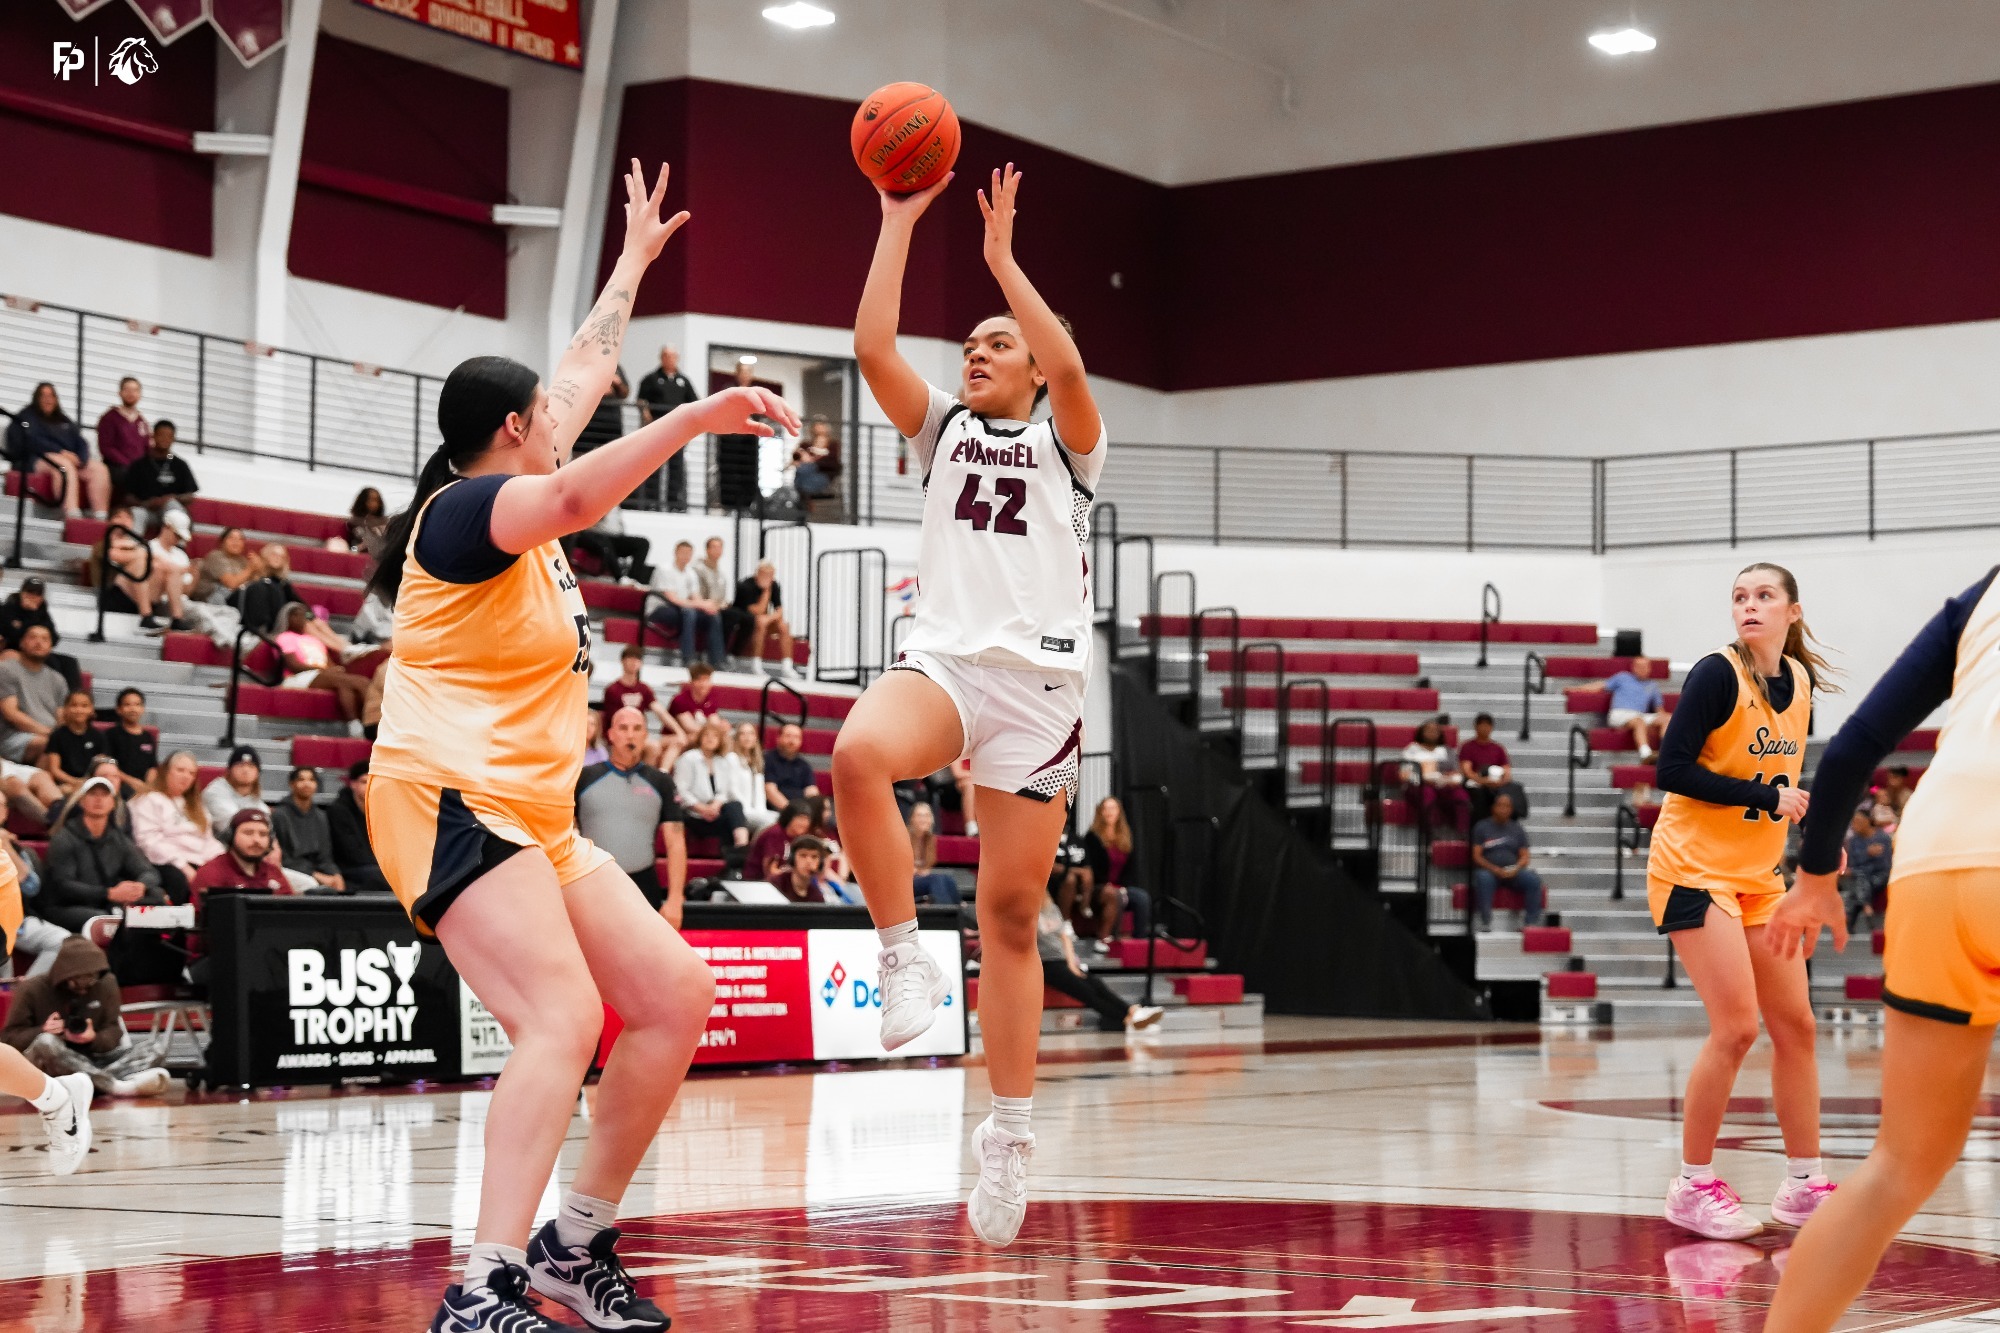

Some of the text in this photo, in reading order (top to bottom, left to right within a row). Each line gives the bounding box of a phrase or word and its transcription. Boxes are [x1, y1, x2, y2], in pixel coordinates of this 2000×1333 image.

[870, 108, 931, 168] SPALDING
[893, 135, 942, 184] LEGACY
[950, 437, 1038, 469] EVANGEL
[955, 473, 1028, 536] 42
[1748, 726, 1799, 761] Spires
[711, 946, 744, 960] SERVICE
[288, 948, 392, 1007] BJS
[289, 1006, 418, 1046] TROPHY
[276, 1048, 437, 1069] AWARDS SIGNS APPAREL
